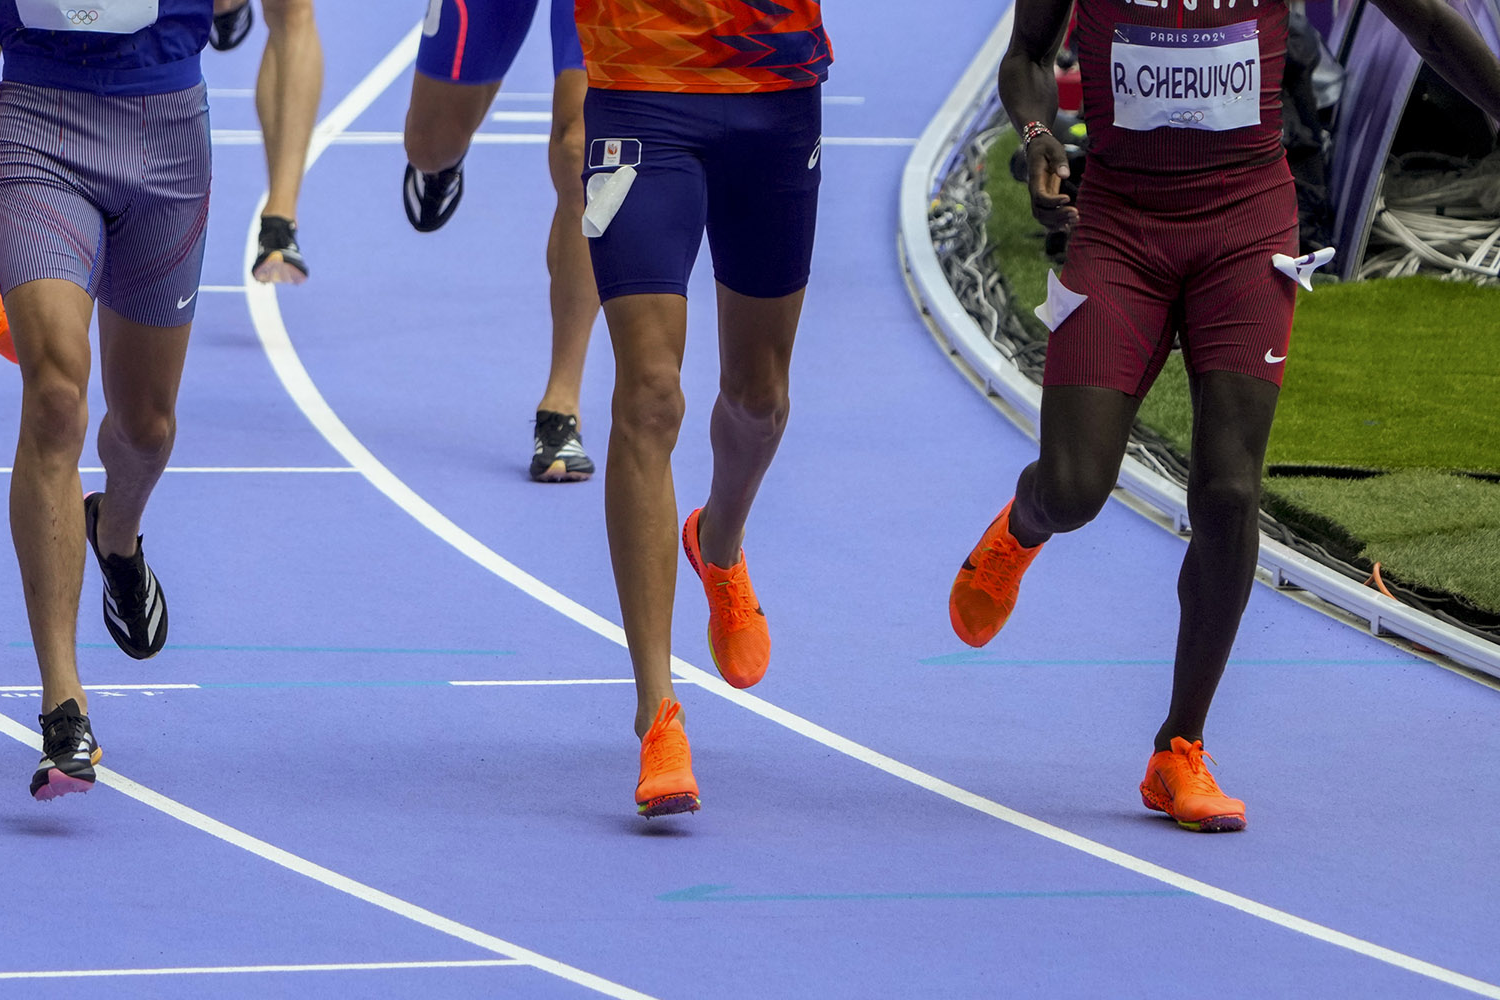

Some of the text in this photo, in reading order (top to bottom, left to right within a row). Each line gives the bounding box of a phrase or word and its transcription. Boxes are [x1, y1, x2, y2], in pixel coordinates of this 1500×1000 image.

[1150, 32, 1226, 43] PARIS 2024
[1114, 59, 1256, 99] R. CHERUIYOT
